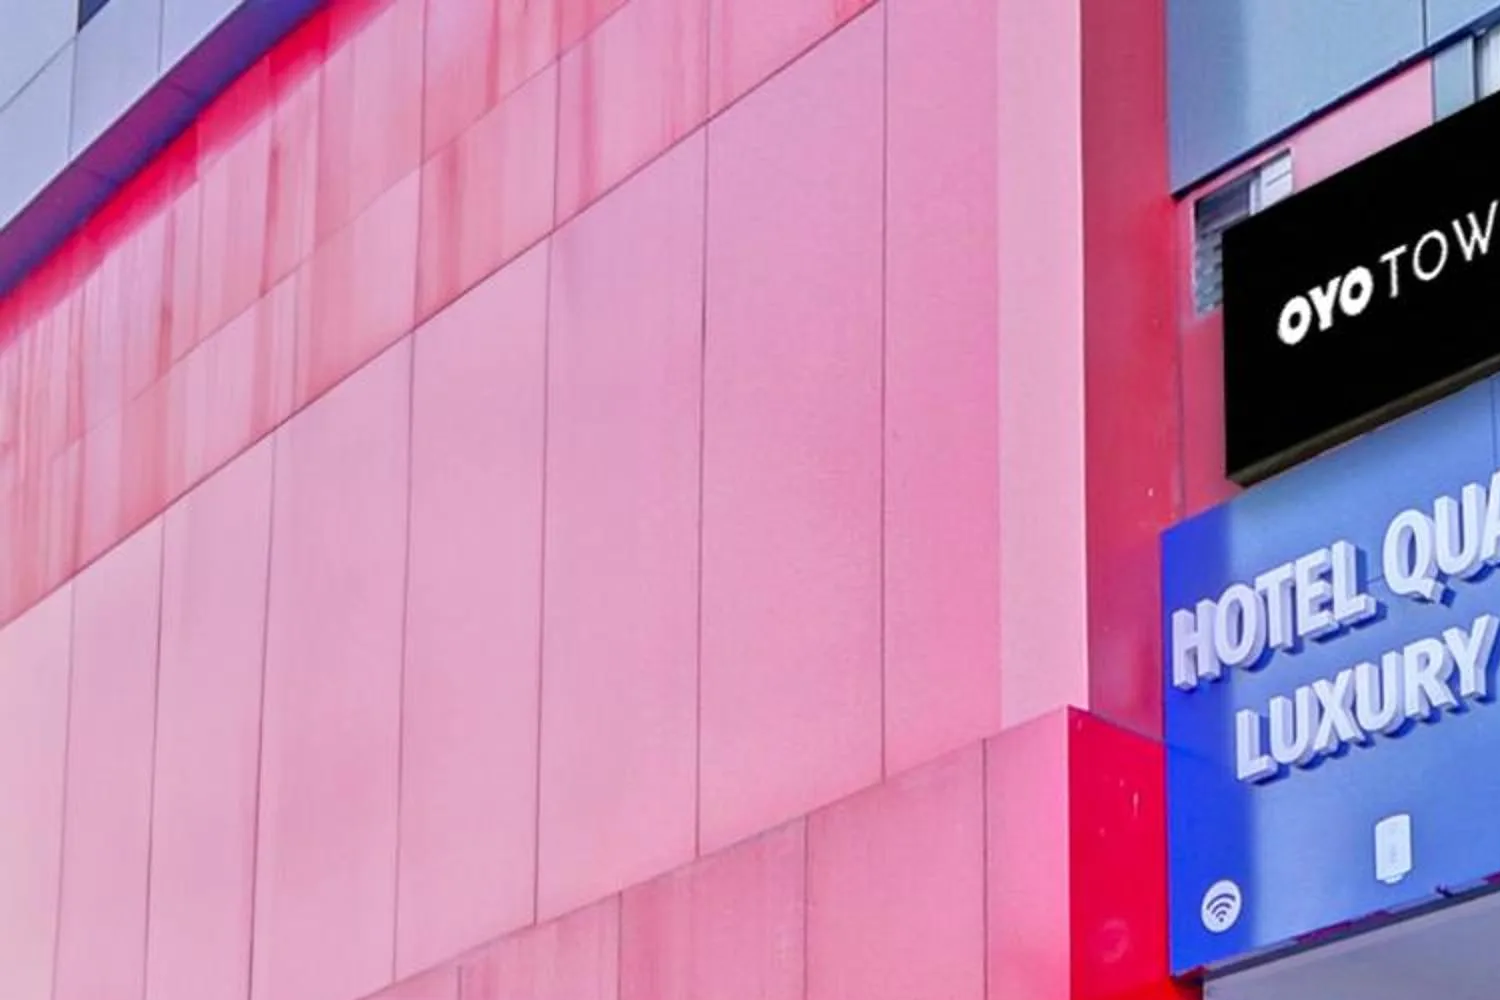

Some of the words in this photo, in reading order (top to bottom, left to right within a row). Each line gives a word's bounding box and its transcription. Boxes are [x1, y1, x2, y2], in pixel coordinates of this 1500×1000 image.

[1277, 267, 1373, 346] OYO
[1171, 539, 1376, 690] HOTEL
[1235, 614, 1500, 782] LUXURY
